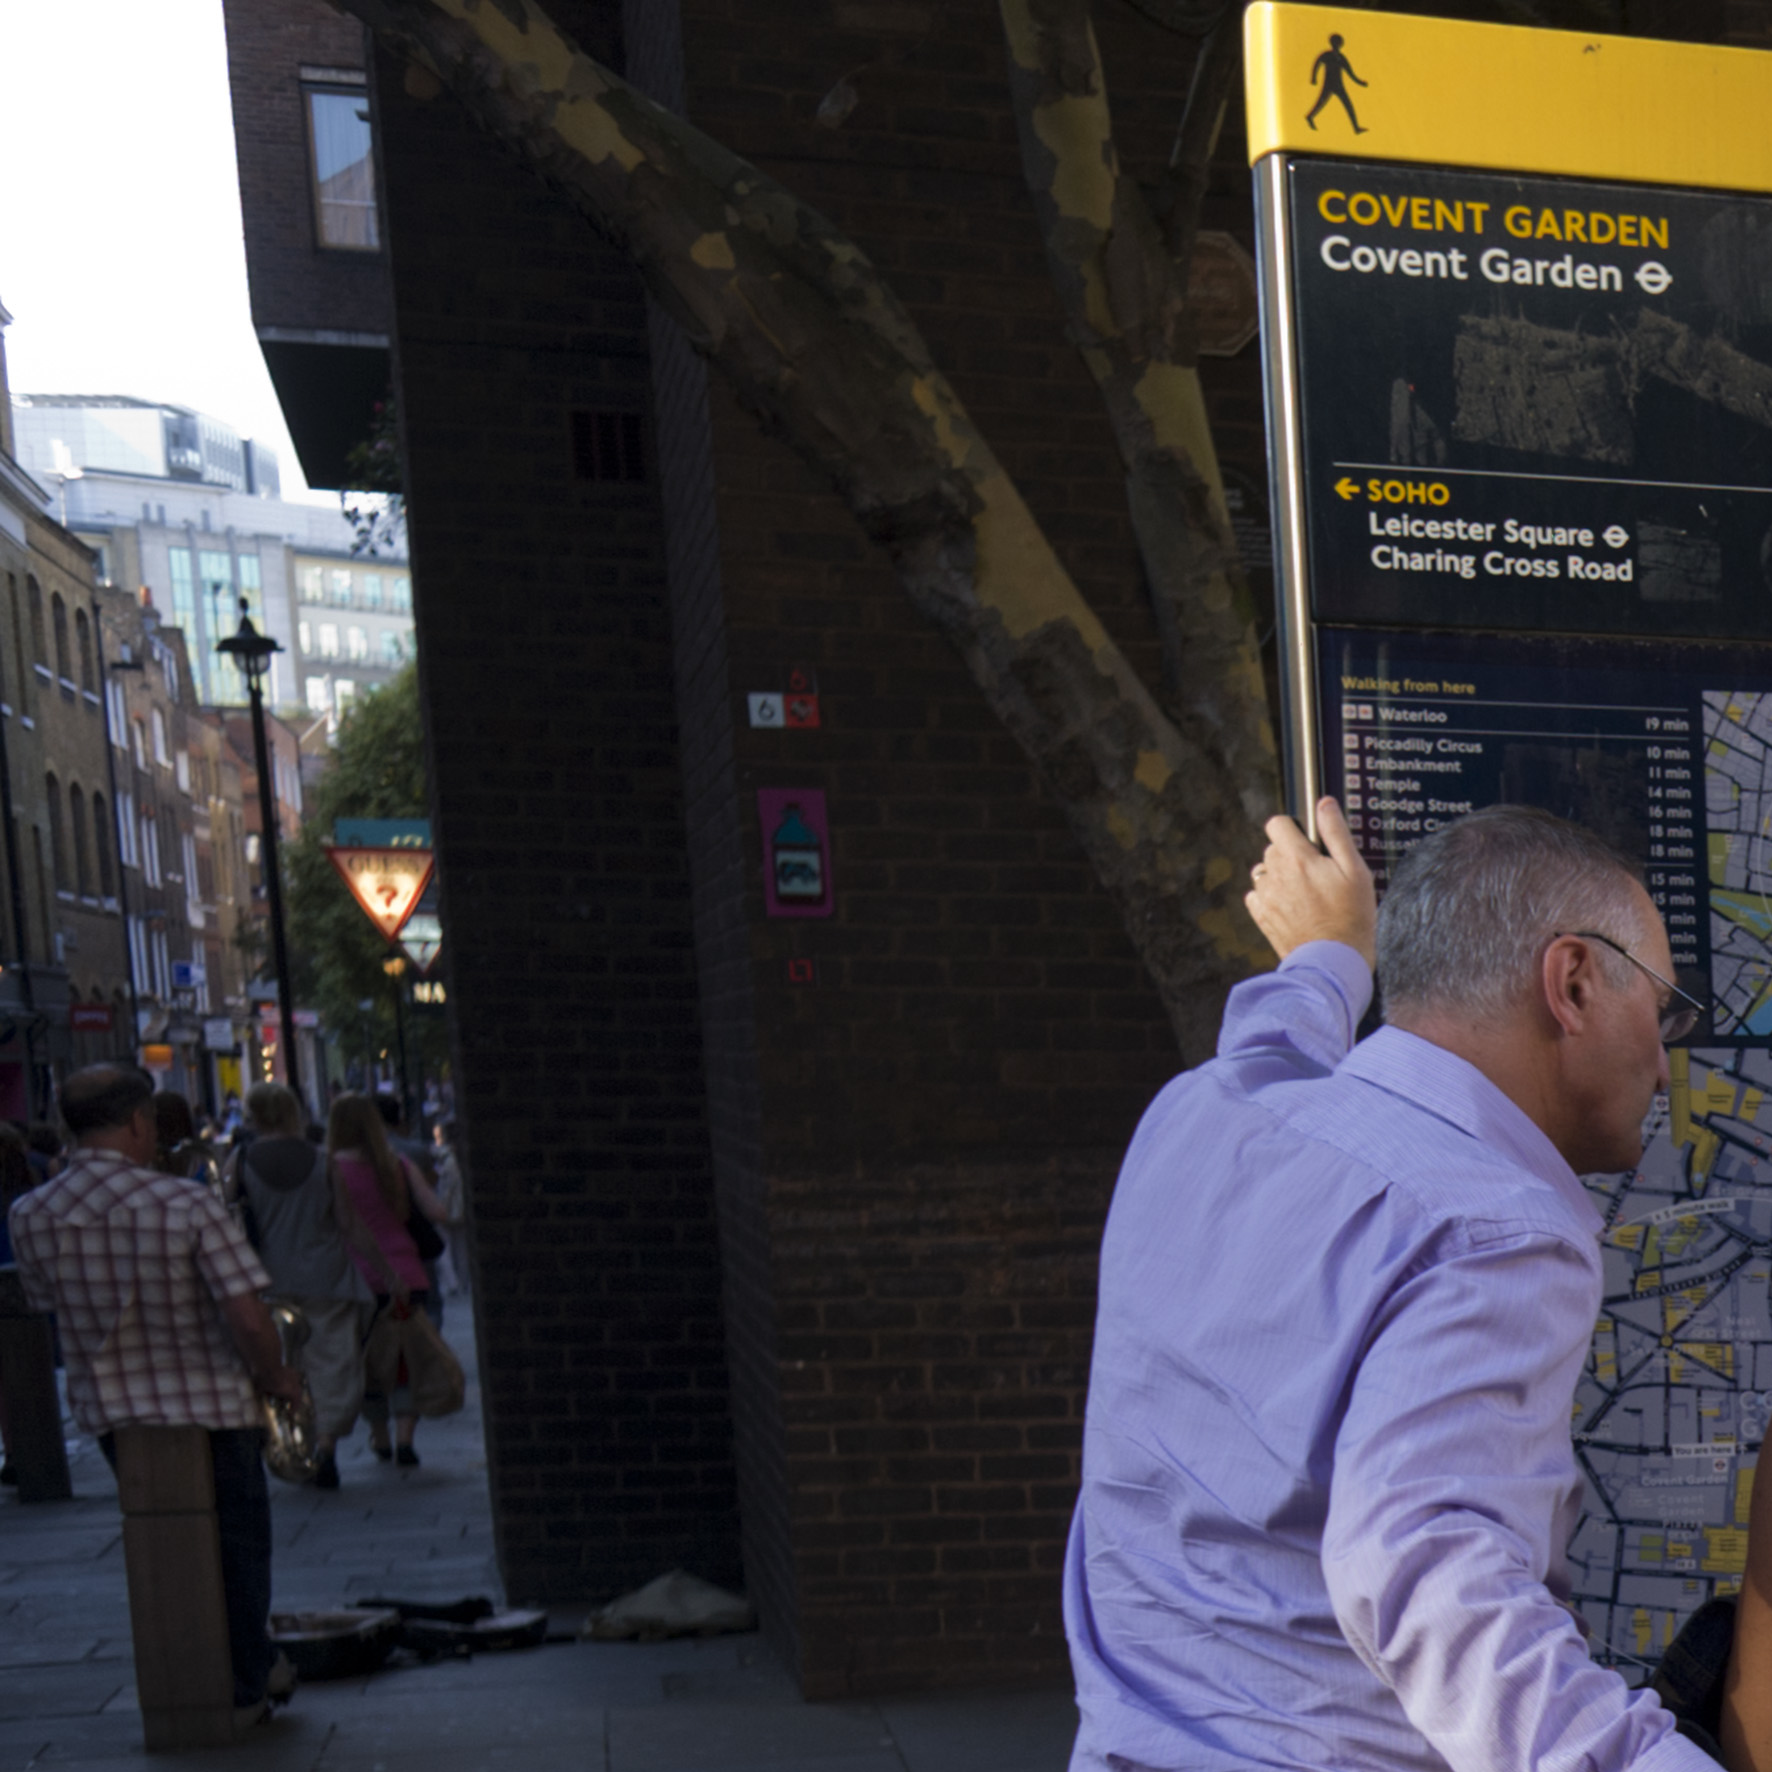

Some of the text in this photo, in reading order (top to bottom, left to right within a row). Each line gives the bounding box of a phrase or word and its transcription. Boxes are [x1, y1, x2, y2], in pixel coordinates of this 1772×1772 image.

[1316, 189, 1670, 250] COVENT GARDEN
[1320, 237, 1623, 292] Covent Garden
[1367, 478, 1450, 508] SOHO
[1369, 513, 1595, 553] Leicester Square
[1371, 546, 1634, 583] Charing Cross Road
[1341, 676, 1476, 695] Walking from here
[1378, 707, 1690, 732] Waterloo 19 min
[1364, 736, 1691, 760] Piccadilly Circus 10 min
[1365, 757, 1691, 780] Embankment 11 min
[1366, 776, 1692, 800] Temple 14 min
[1367, 797, 1693, 819] Goodge Street 16 min
[1368, 816, 1420, 831] Oxford
[1650, 824, 1663, 838] 18
[1666, 825, 1694, 838] min
[1650, 844, 1664, 857] 18
[1667, 844, 1694, 858] min
[1651, 873, 1695, 886] 15 min
[1669, 893, 1696, 906] min
[1669, 912, 1697, 925] min
[1671, 932, 1697, 944] min
[1672, 951, 1698, 964] min
[1674, 1445, 1731, 1455] You are here
[1641, 1474, 1729, 1487] Covent Garden
[1657, 1494, 1704, 1505] Covent
[1658, 1506, 1705, 1517] Garden
